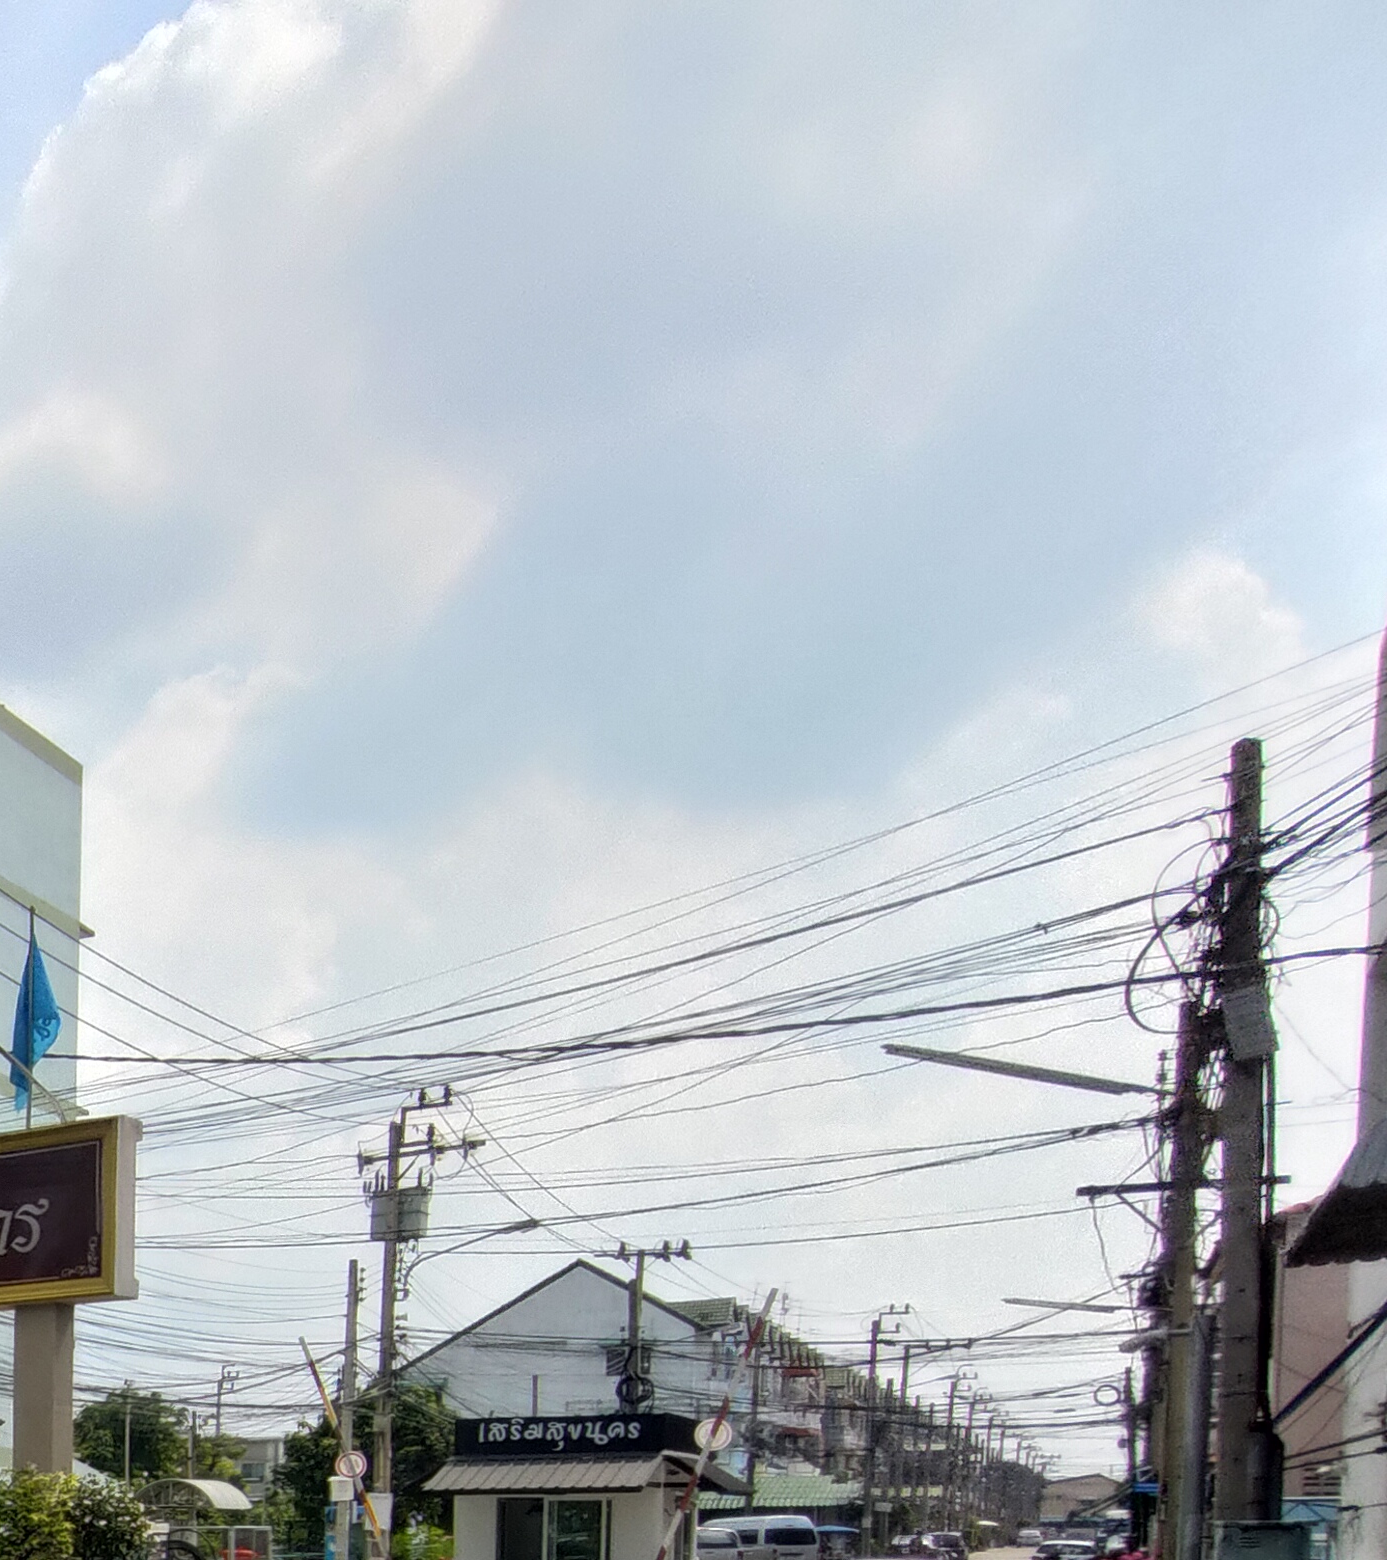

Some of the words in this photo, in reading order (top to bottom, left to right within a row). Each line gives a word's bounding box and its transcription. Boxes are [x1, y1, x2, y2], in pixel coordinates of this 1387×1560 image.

[478, 1418, 641, 1451] เสริมสุขนคร
